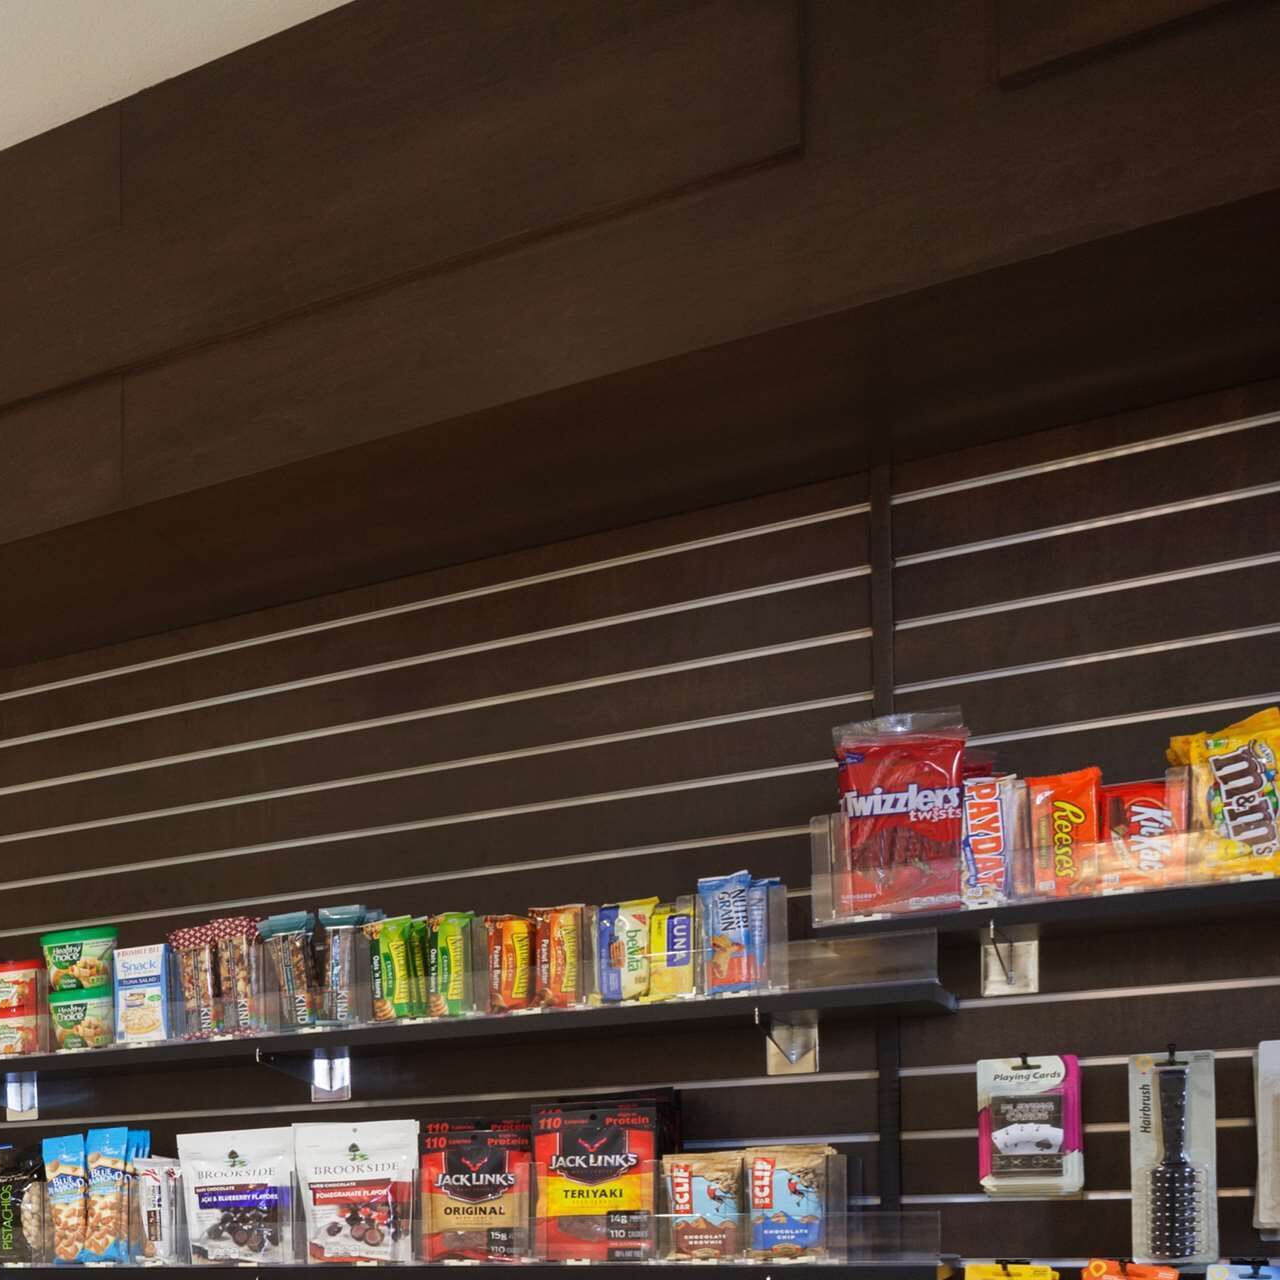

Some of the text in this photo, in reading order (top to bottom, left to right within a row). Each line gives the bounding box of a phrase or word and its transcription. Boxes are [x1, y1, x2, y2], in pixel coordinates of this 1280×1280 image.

[840, 784, 960, 818] Twizzlers
[910, 806, 962, 822] twists
[968, 784, 1005, 885] PAYDAY
[1052, 800, 1086, 878] Reese's
[720, 892, 735, 932] GRAIN
[673, 916, 687, 962] LUNA
[626, 929, 640, 972] belvita
[122, 960, 157, 971] Snack
[58, 1004, 87, 1016] Healthy
[295, 994, 309, 1024] KIND
[337, 990, 349, 1021] KIND
[57, 1012, 85, 1022] Choice
[239, 998, 249, 1029] KIND
[993, 1072, 1030, 1081] Playing
[1141, 1084, 1152, 1134] Hairbrush
[538, 1117, 561, 1129] 110
[605, 1116, 649, 1126] Protein
[425, 1137, 447, 1149] 110
[487, 1137, 528, 1146] Protein
[548, 1153, 638, 1170] JACK LINK'S
[90, 1168, 112, 1177] BLUE
[198, 1167, 276, 1179] BROOKSIDE
[314, 1162, 399, 1176] BROOKSIDE
[52, 1177, 74, 1186] BLUE
[435, 1174, 516, 1187] JACK LINK'S
[675, 1167, 689, 1203] CLIF
[754, 1160, 772, 1197] CLIF
[563, 1189, 624, 1199] TERIYAKI
[2, 1184, 13, 1250] PISTACHIOS
[444, 1206, 505, 1216] ORIGINAL
[610, 1214, 628, 1224] 14g
[490, 1231, 507, 1241] 15g
[610, 1229, 626, 1239] 110
